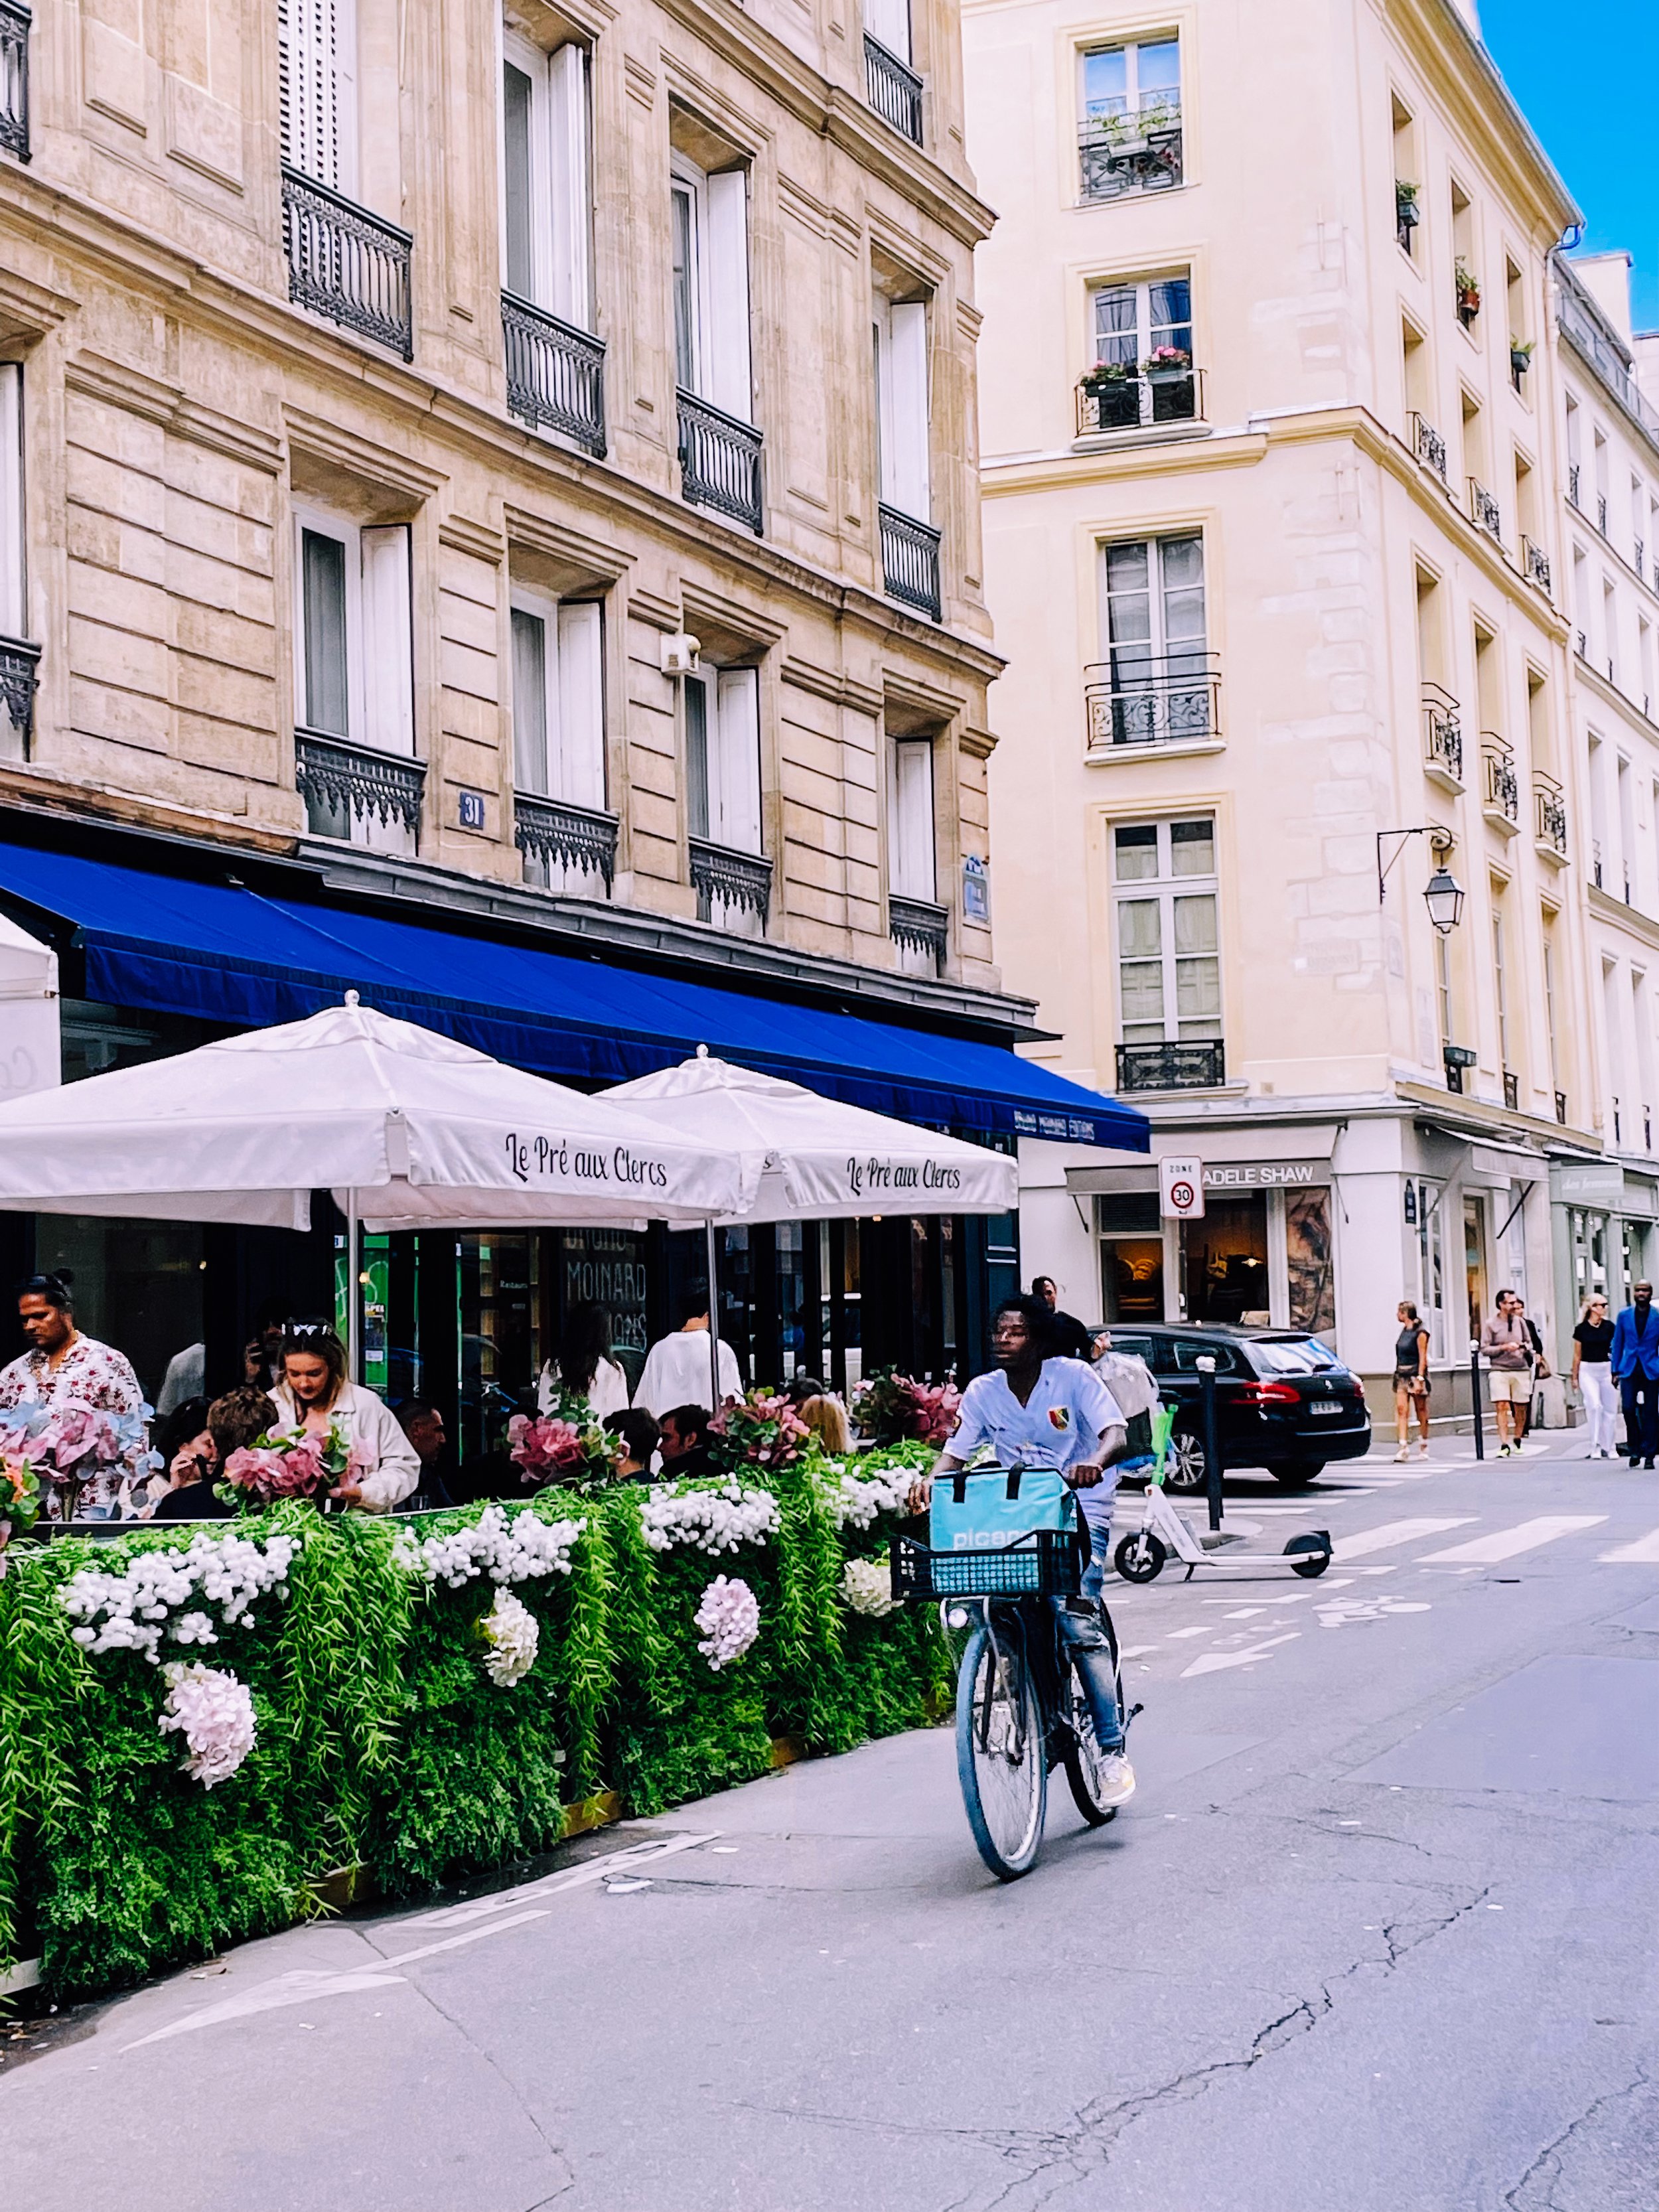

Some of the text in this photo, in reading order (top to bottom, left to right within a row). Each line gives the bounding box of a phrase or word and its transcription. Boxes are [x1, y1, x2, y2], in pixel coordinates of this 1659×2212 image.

[465, 796, 480, 824] 31
[506, 1133, 667, 1187] Le Pré aux Clercs
[1169, 1165, 1192, 1173] ZONE
[847, 1157, 960, 1197] Le Pré aux Clercs
[1202, 1166, 1313, 1185] ADELE SHAW
[1176, 1189, 1190, 1201] 30
[567, 1262, 646, 1301] MOINARD
